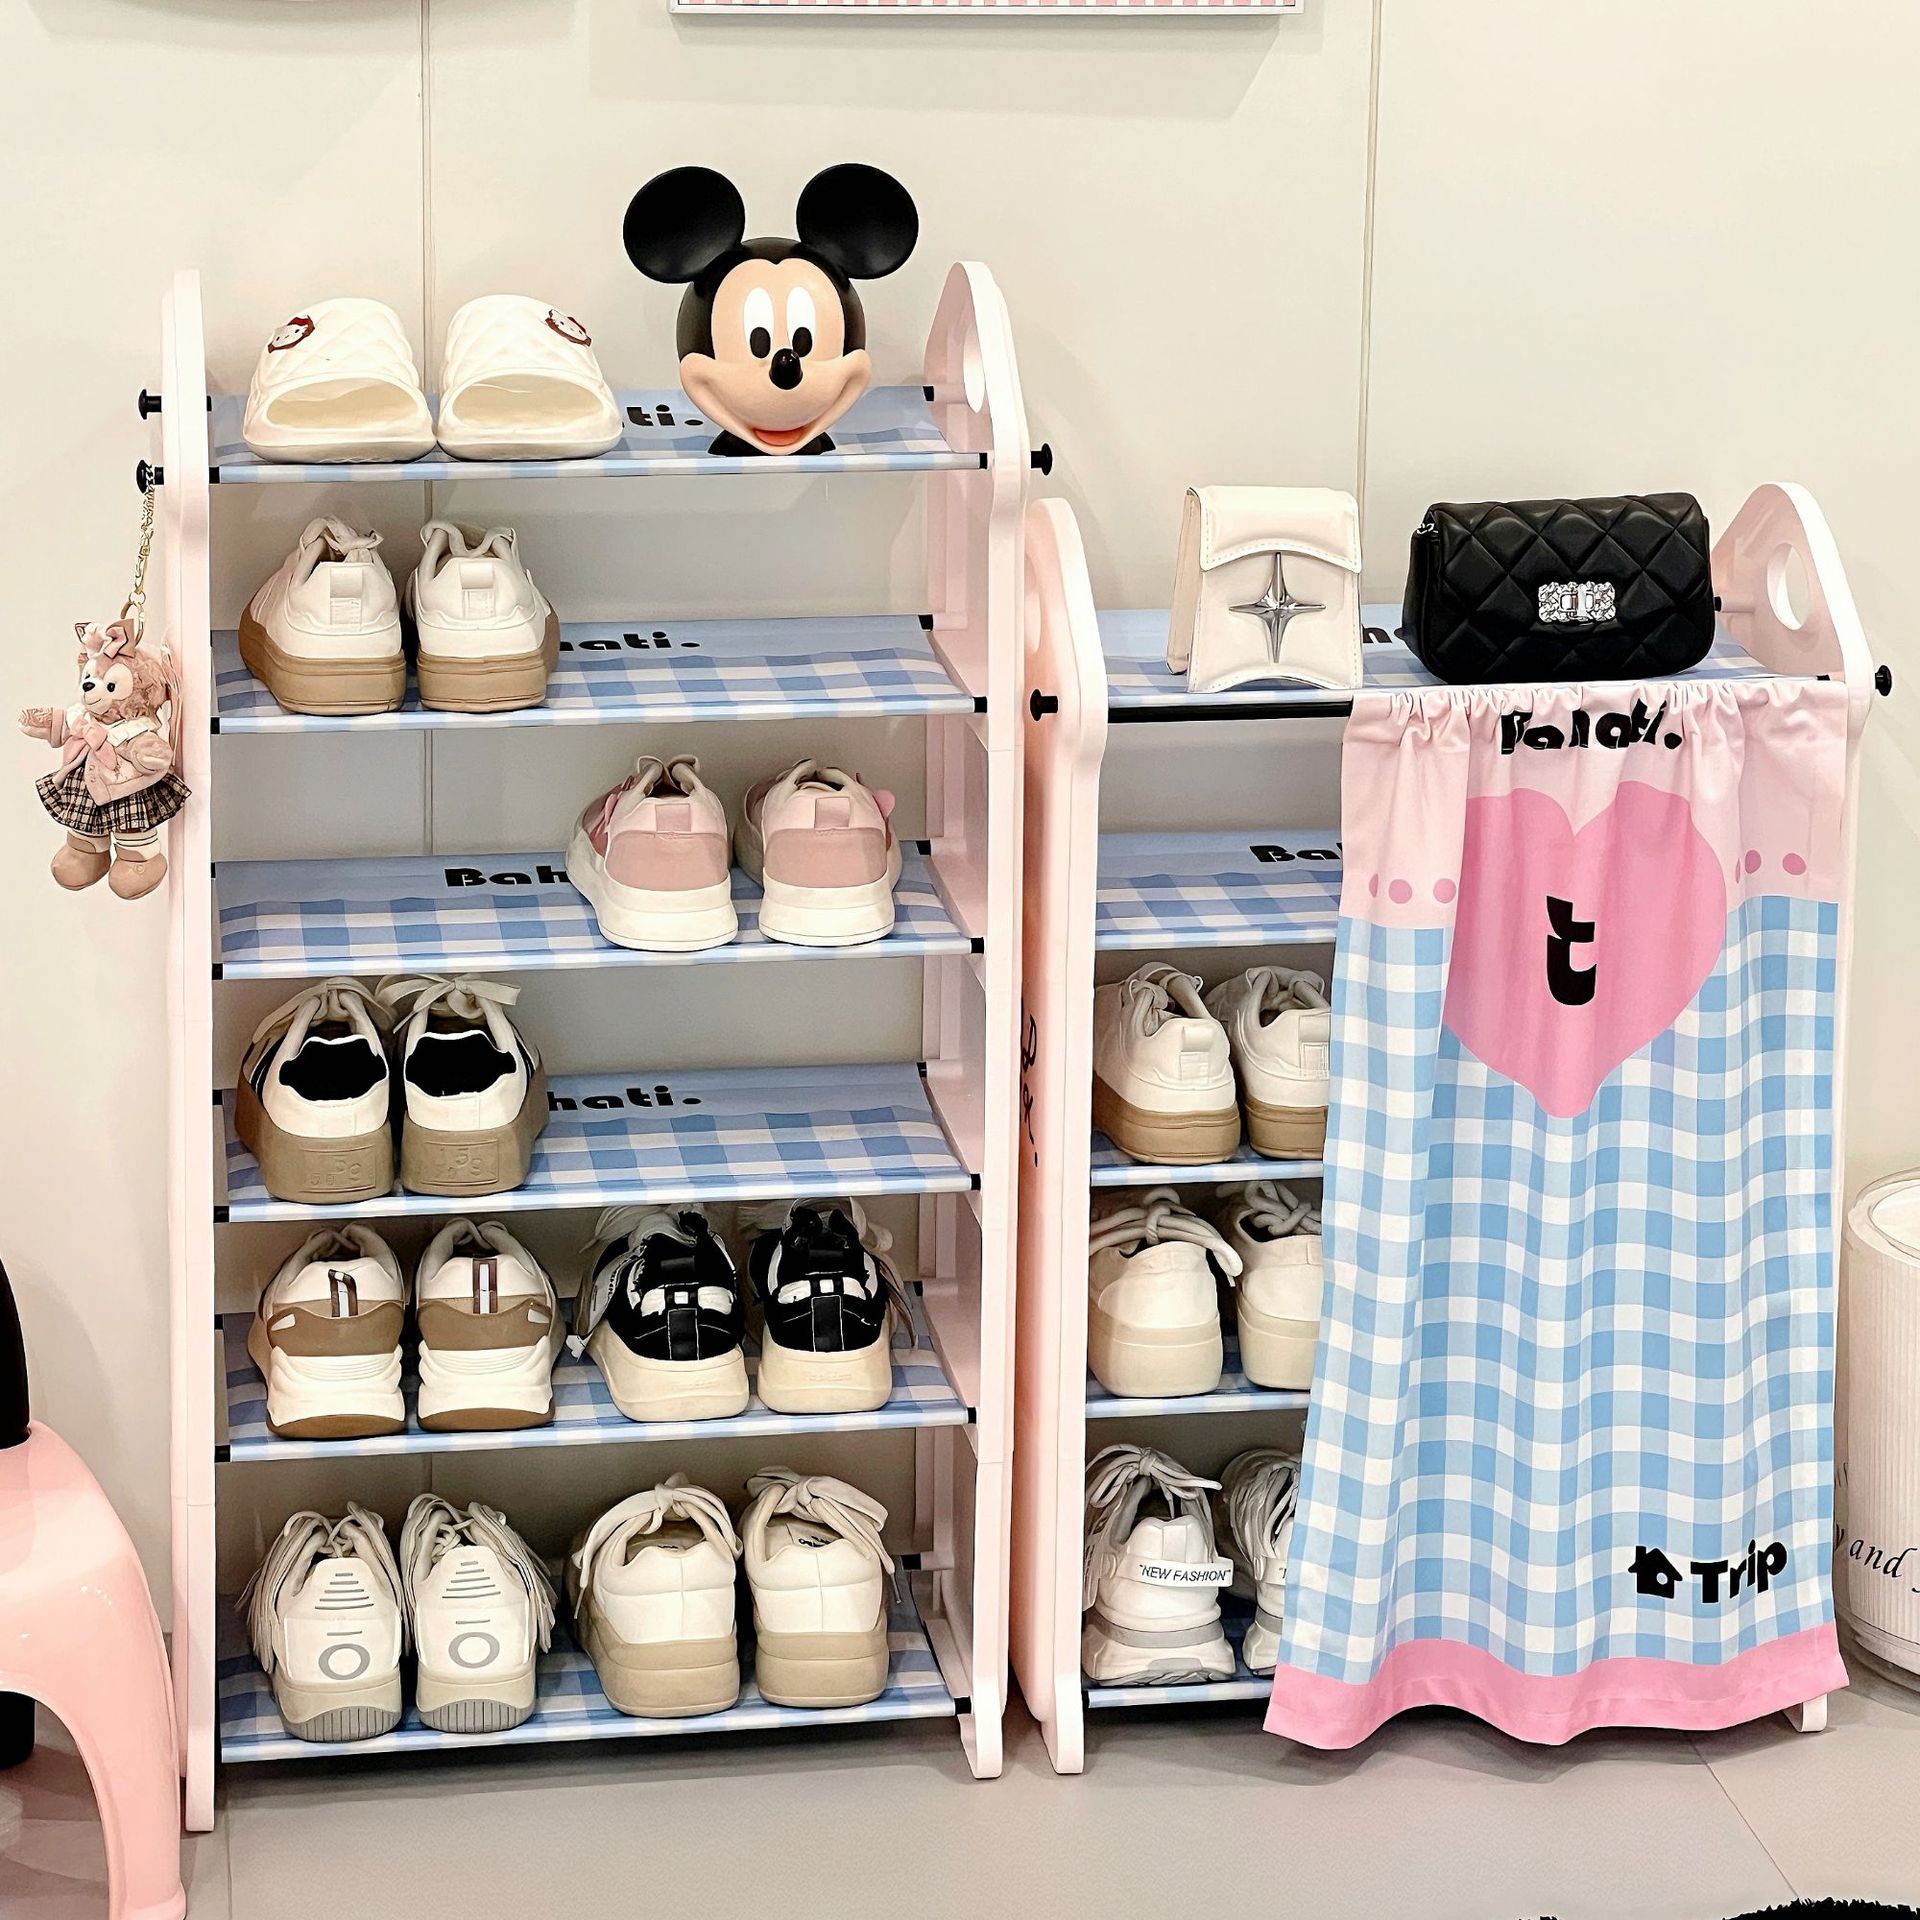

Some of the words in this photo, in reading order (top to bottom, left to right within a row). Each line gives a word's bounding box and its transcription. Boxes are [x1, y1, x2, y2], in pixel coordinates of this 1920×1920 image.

[560, 631, 700, 651] ati.
[547, 1085, 702, 1111] hati.
[1690, 1539, 1788, 1603] Trip
[1849, 1539, 1918, 1579] and
